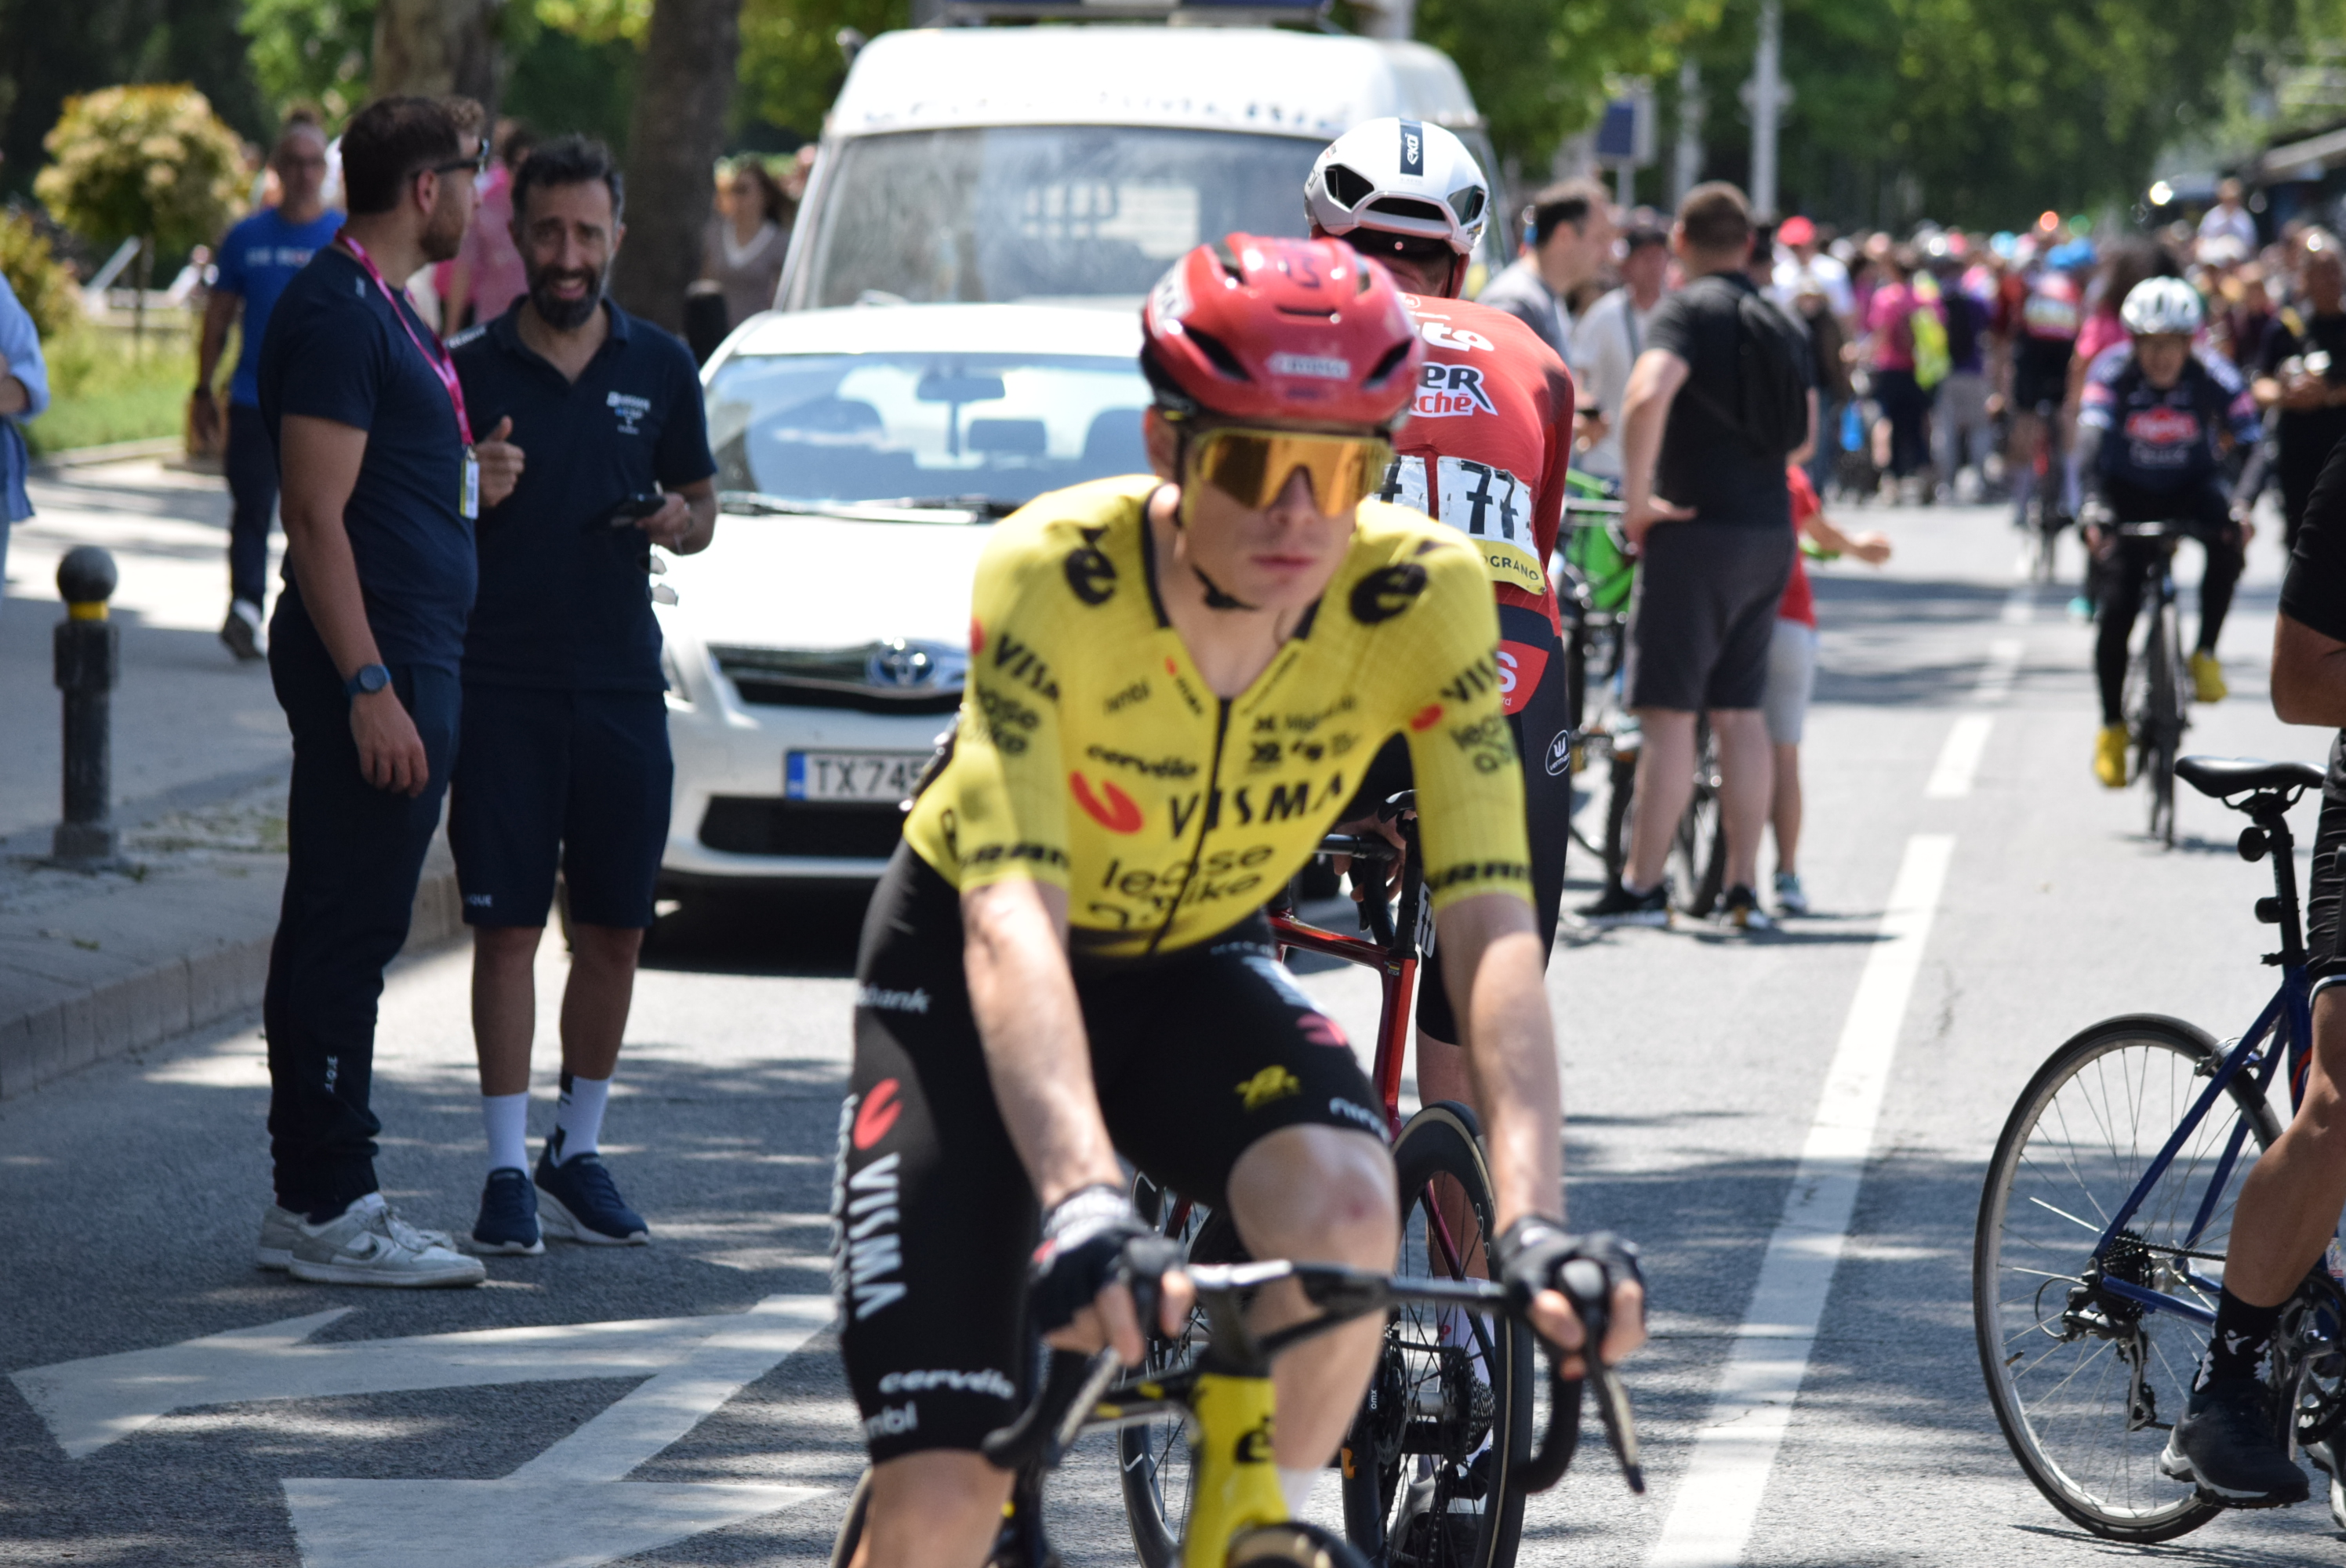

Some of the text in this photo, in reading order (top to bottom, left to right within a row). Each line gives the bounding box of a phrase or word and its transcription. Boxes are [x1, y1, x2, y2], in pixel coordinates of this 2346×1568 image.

[1459, 459, 1519, 541] 77
[1168, 772, 1342, 840] VISMA
[849, 1151, 906, 1319] VISMA
